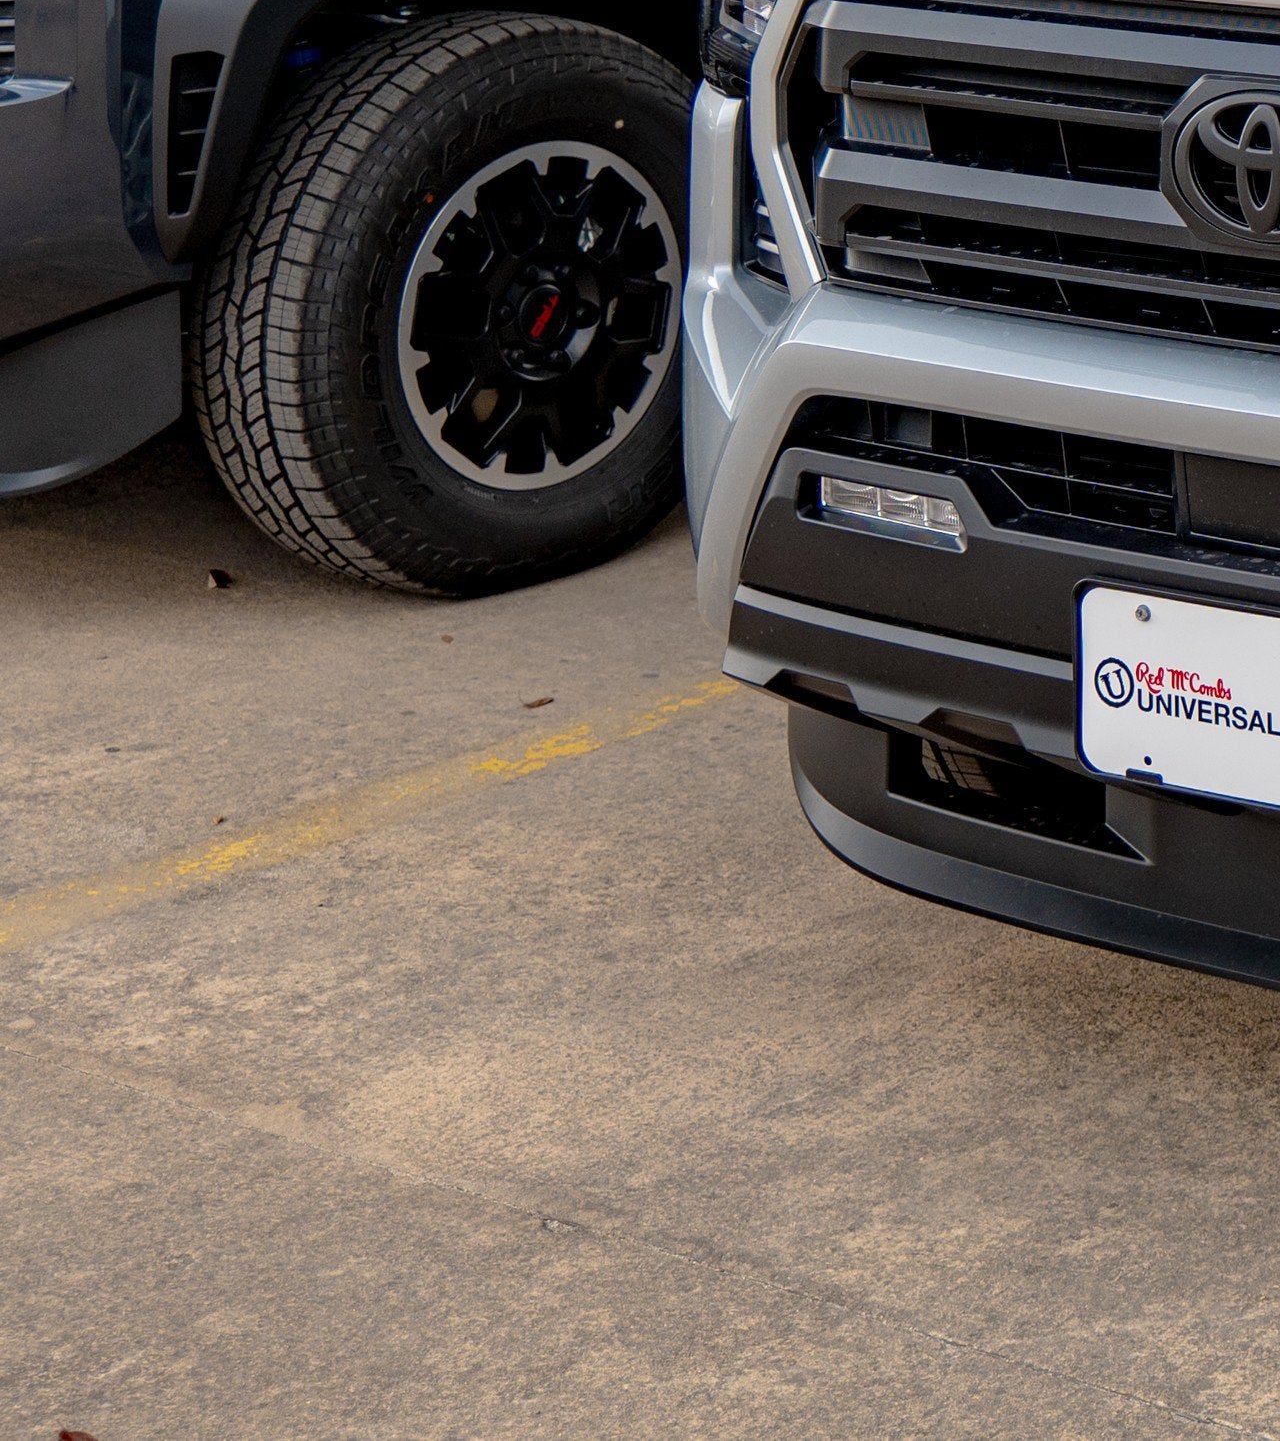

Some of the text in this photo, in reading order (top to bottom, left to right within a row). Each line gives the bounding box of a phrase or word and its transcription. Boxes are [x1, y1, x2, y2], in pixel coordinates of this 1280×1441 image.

[1136, 662, 1232, 701] Red McCombs
[1137, 688, 1280, 737] UNIVERSAL
